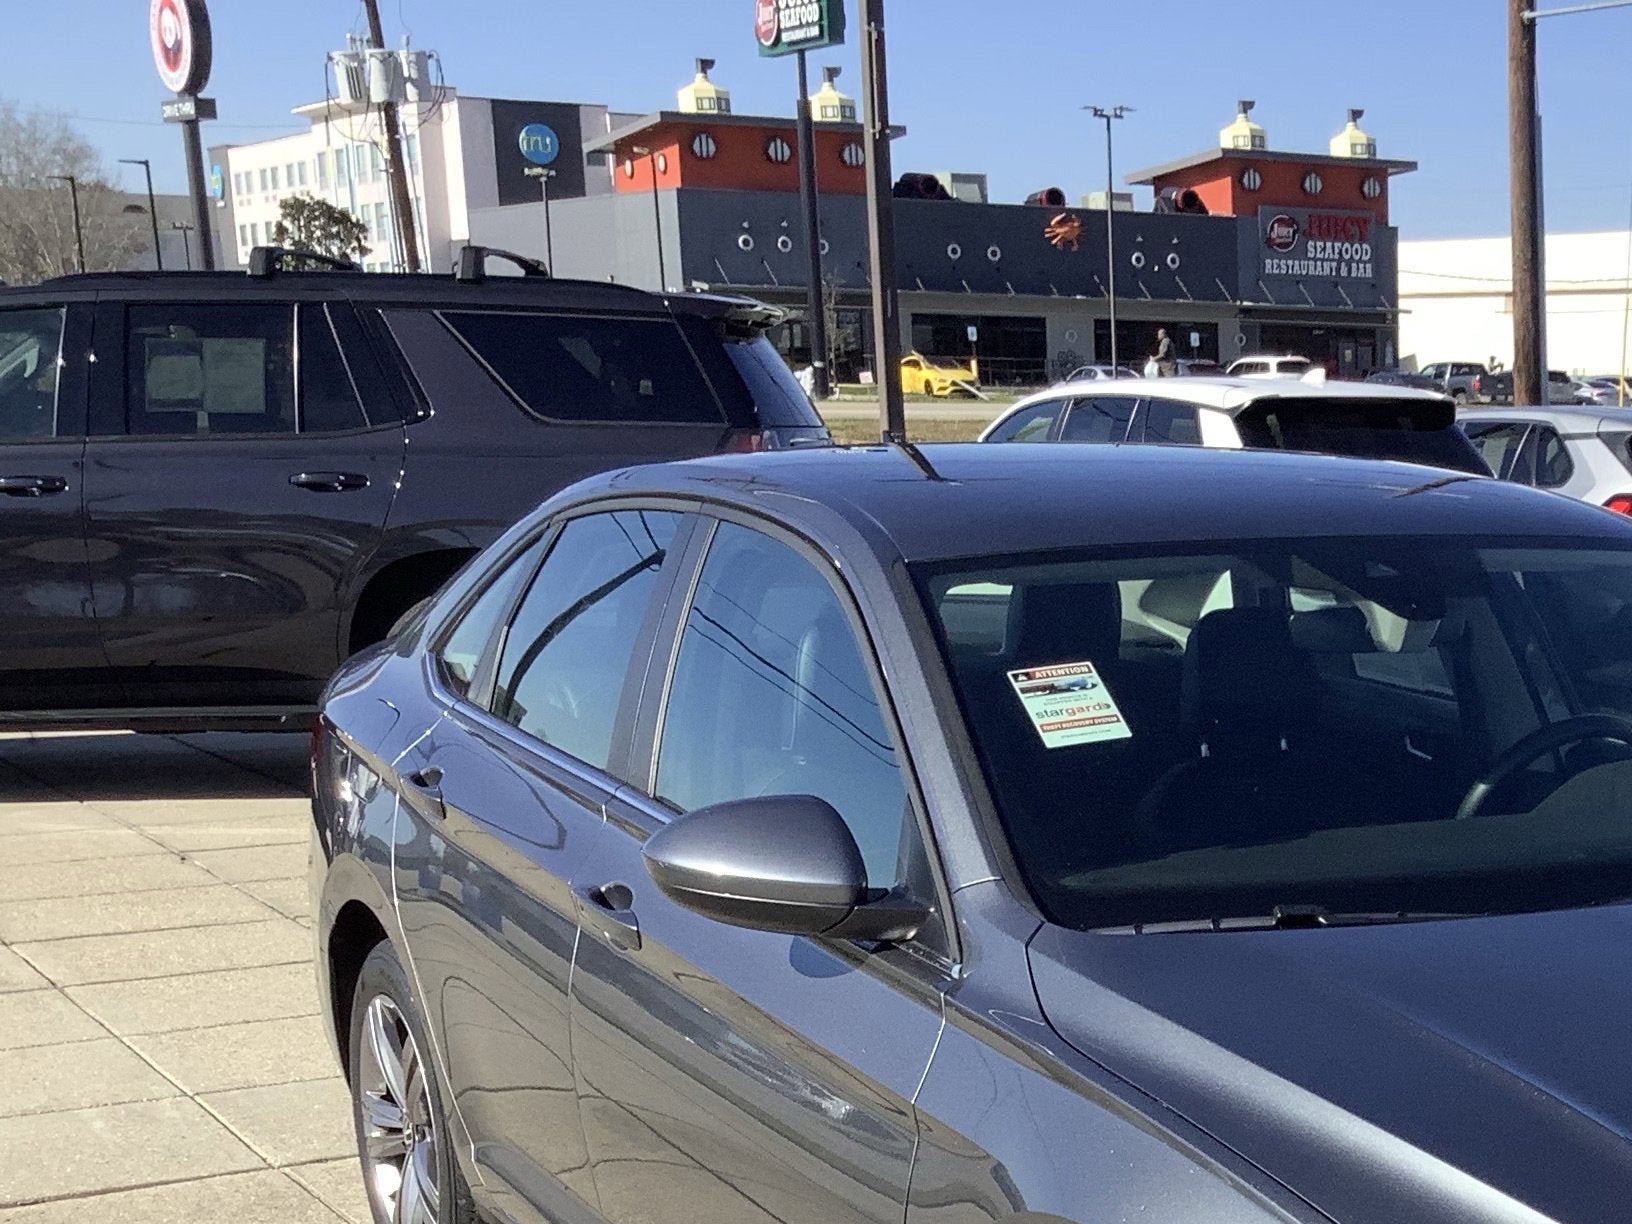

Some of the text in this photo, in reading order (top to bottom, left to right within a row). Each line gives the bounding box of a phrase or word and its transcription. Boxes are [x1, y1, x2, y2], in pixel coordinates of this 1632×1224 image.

[779, 2, 820, 29] SEAFOOD
[1303, 213, 1371, 241] JUICY
[1307, 240, 1372, 261] SEAFOOD
[1265, 258, 1373, 278] RESTAURANT & BAR
[1034, 665, 1090, 680] ATTENTION
